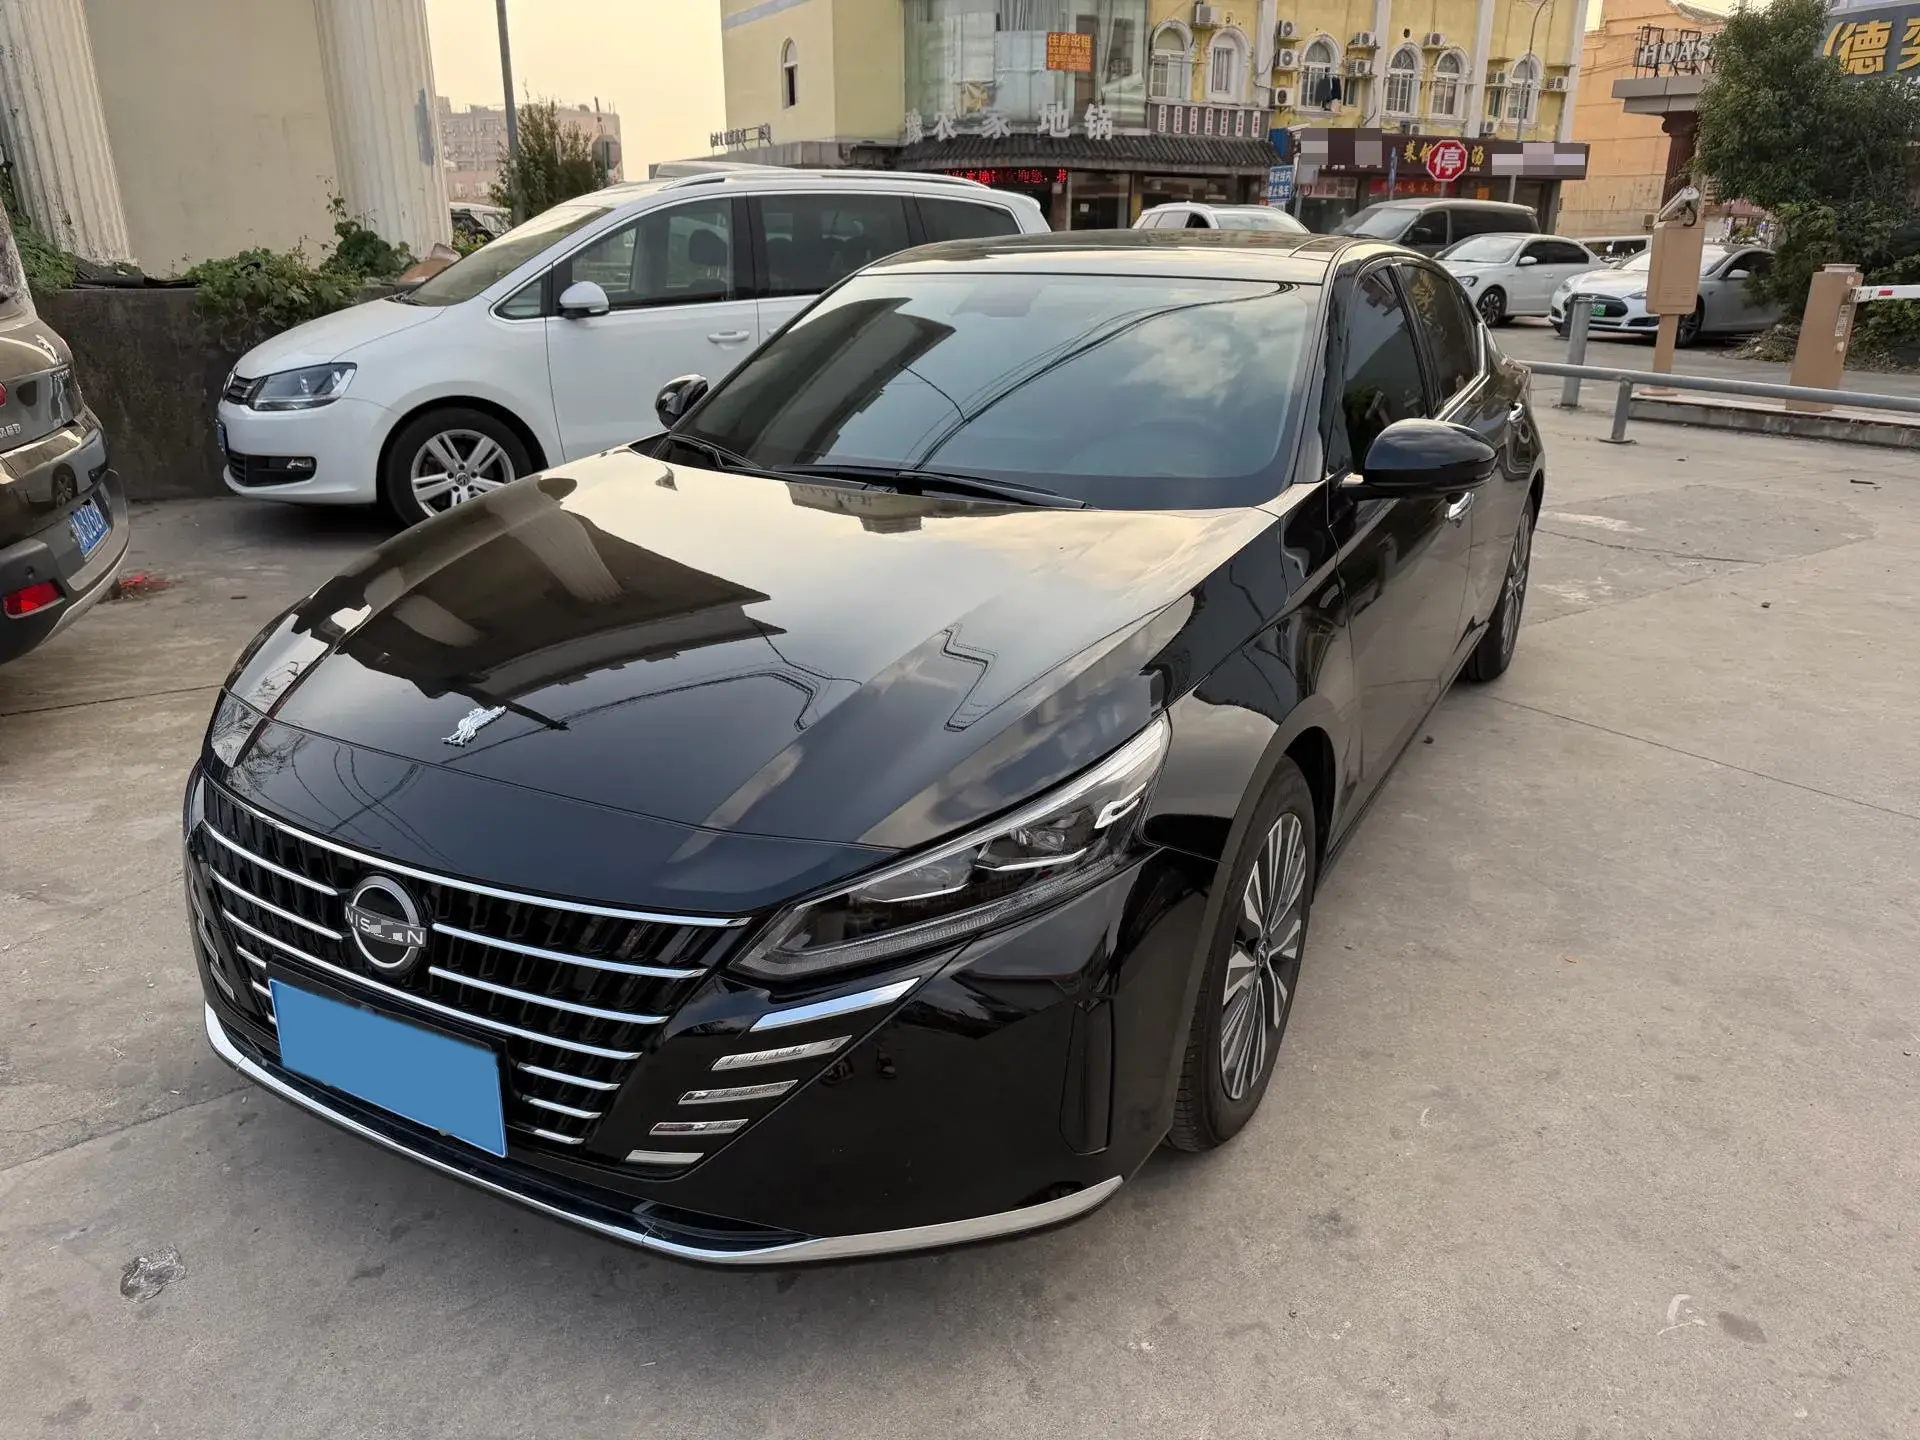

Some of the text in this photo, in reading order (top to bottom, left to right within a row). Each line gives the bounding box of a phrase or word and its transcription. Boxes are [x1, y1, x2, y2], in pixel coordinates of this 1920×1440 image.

[1640, 38, 1712, 66] HUAS
[1434, 146, 1461, 175] 停
[344, 905, 423, 945] NISN
